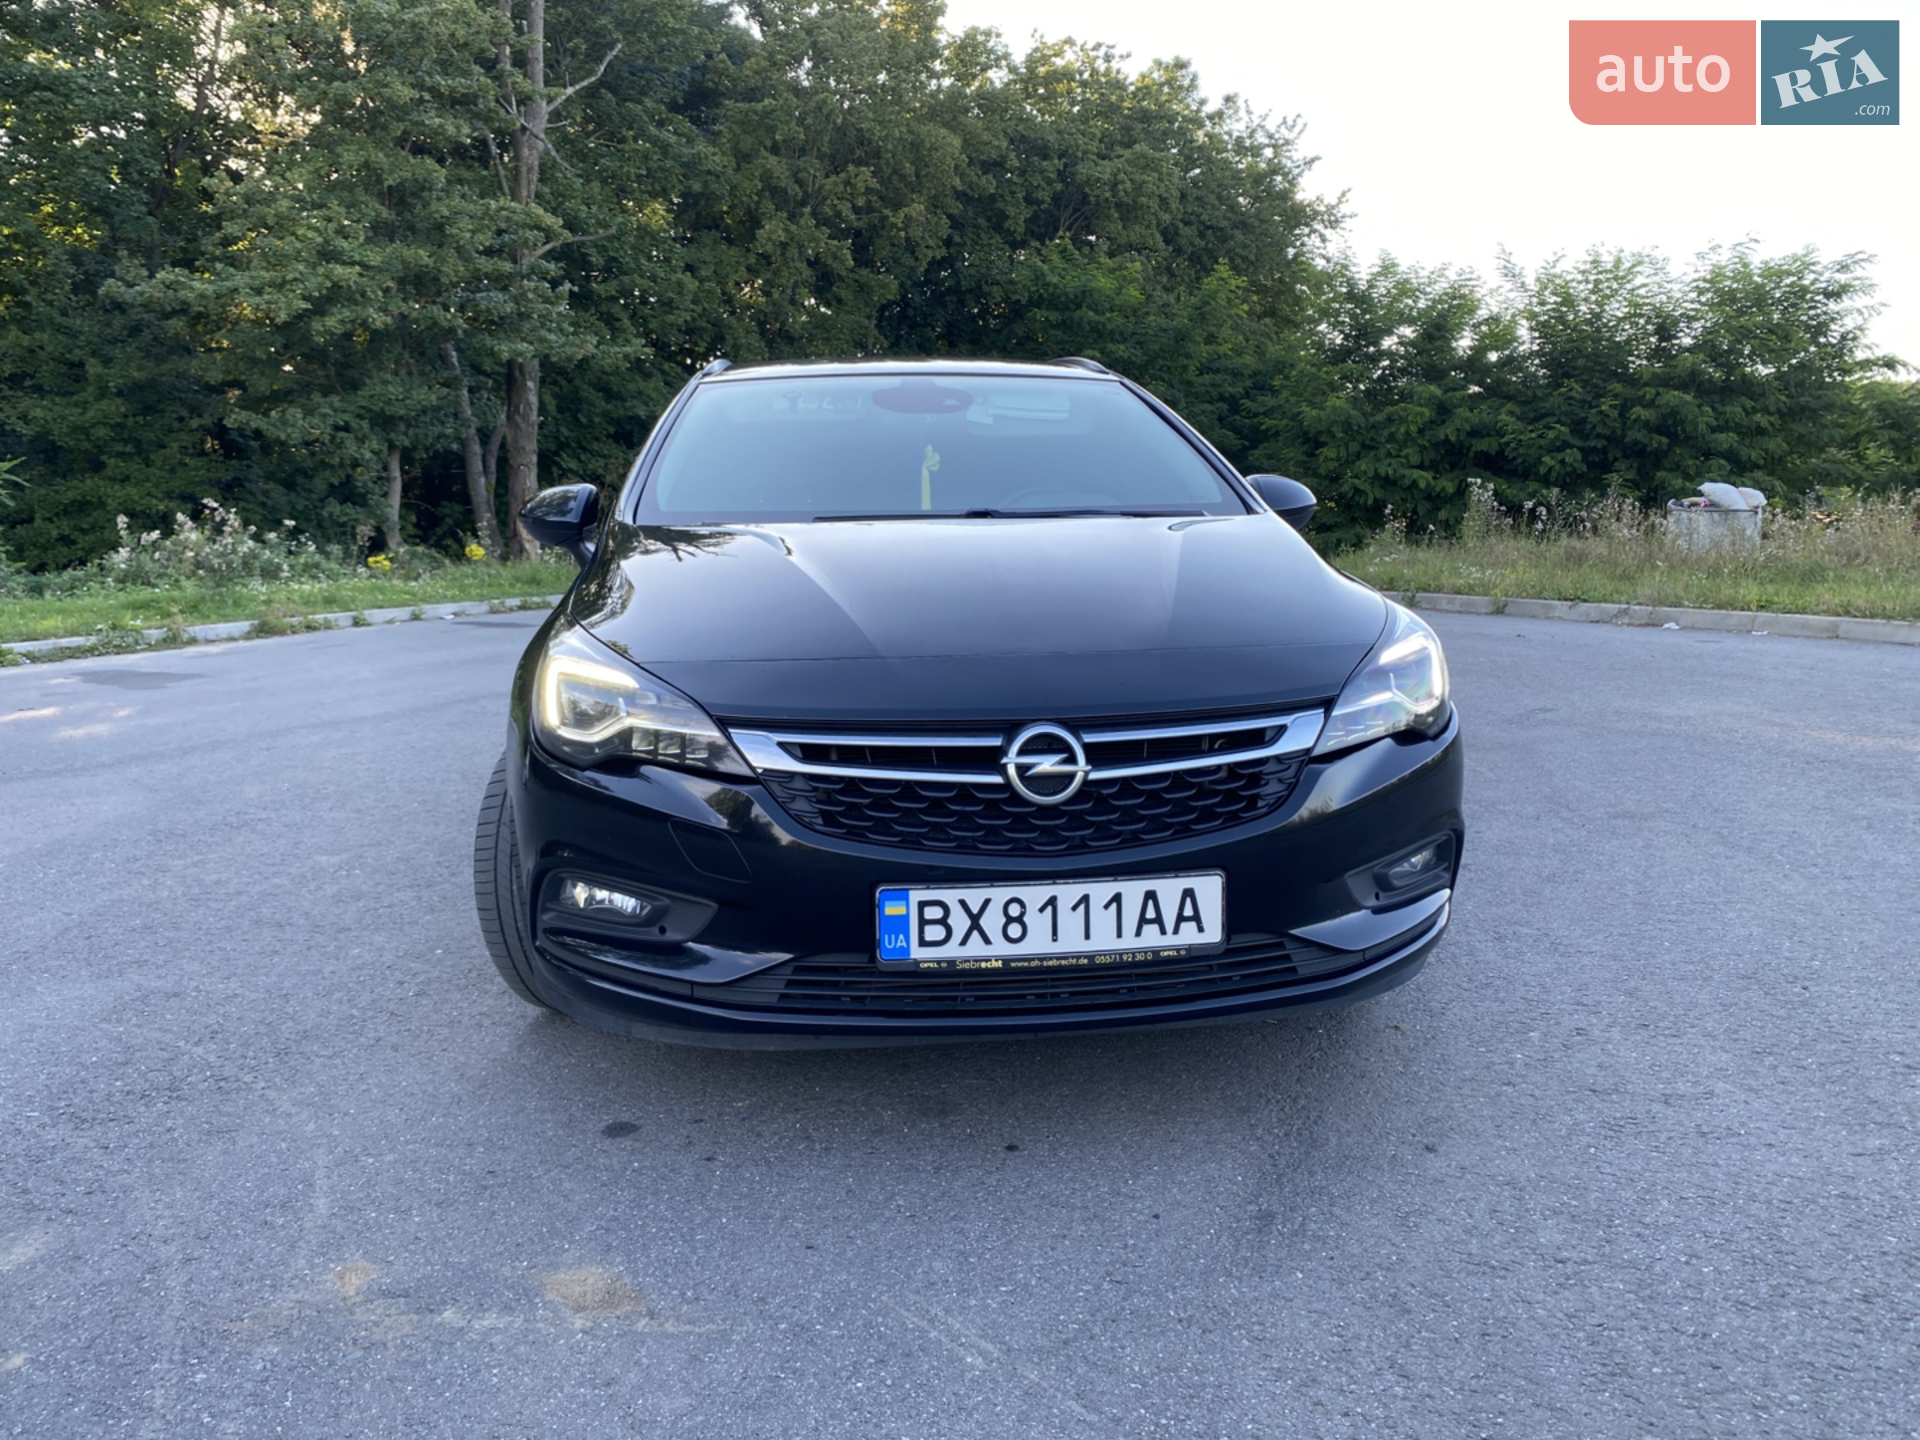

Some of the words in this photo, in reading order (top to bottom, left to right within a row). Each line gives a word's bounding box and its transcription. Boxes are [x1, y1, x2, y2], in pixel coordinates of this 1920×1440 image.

[917, 887, 1206, 948] BX8111AA
[884, 934, 908, 949] UA
[955, 959, 1003, 969] Siebrecht
[1095, 955, 1120, 964] 05571
[1122, 953, 1133, 962] 92
[1134, 952, 1145, 961] 30
